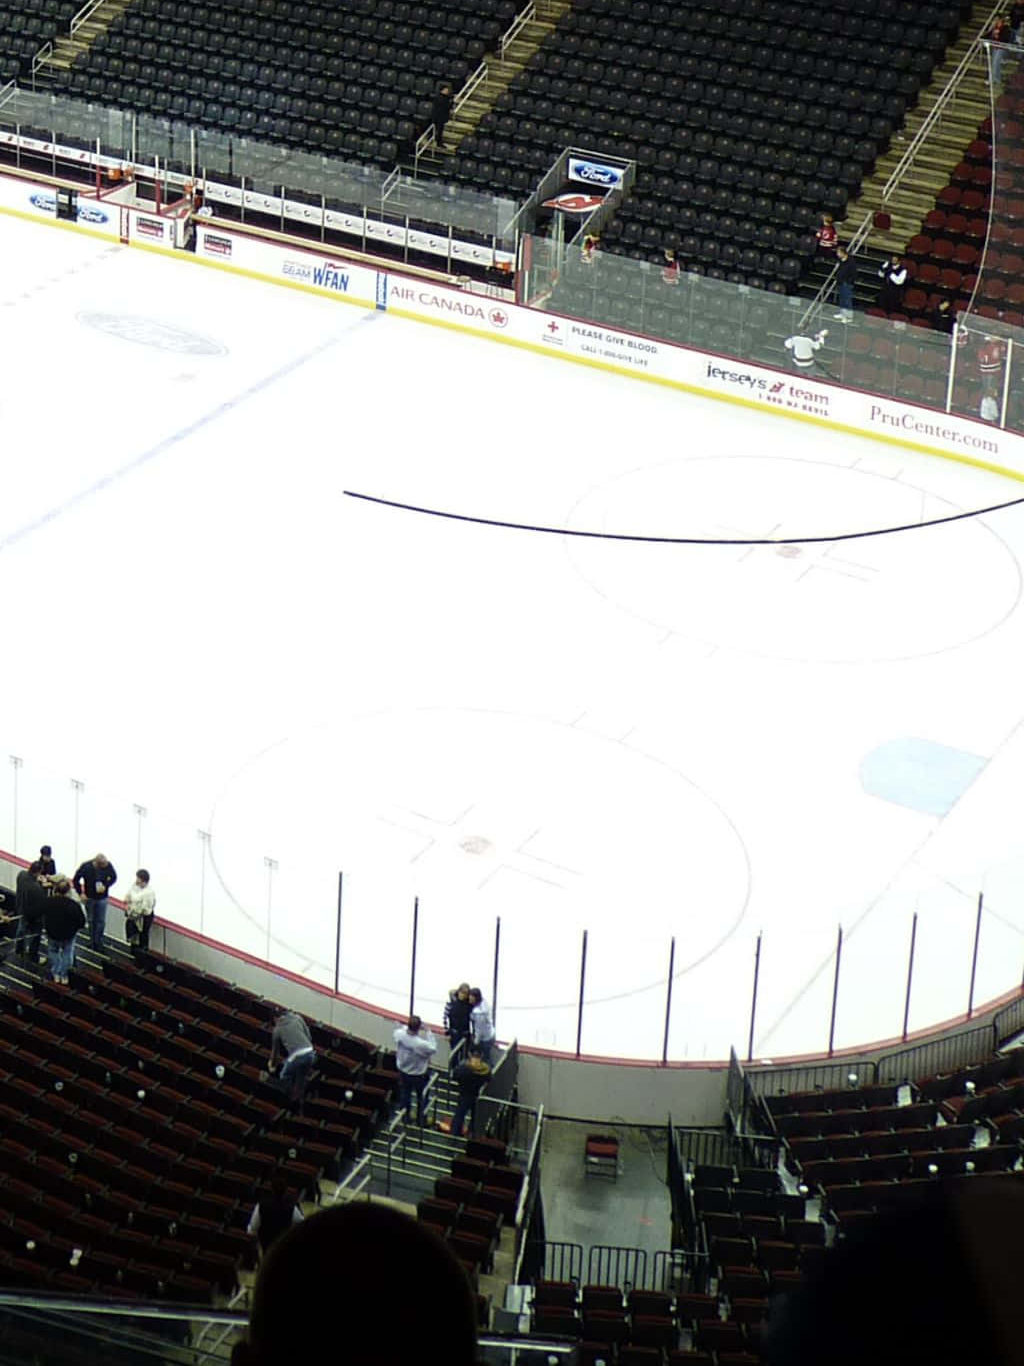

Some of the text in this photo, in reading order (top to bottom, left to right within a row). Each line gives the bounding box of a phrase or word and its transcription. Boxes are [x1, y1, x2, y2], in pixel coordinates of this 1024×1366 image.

[313, 262, 350, 293] WFAN
[390, 285, 486, 320] AIR CANADA
[571, 326, 603, 340] PLEASE
[605, 334, 625, 347] GIVE
[789, 386, 829, 406] team
[869, 405, 1000, 454] PruCenter.com
